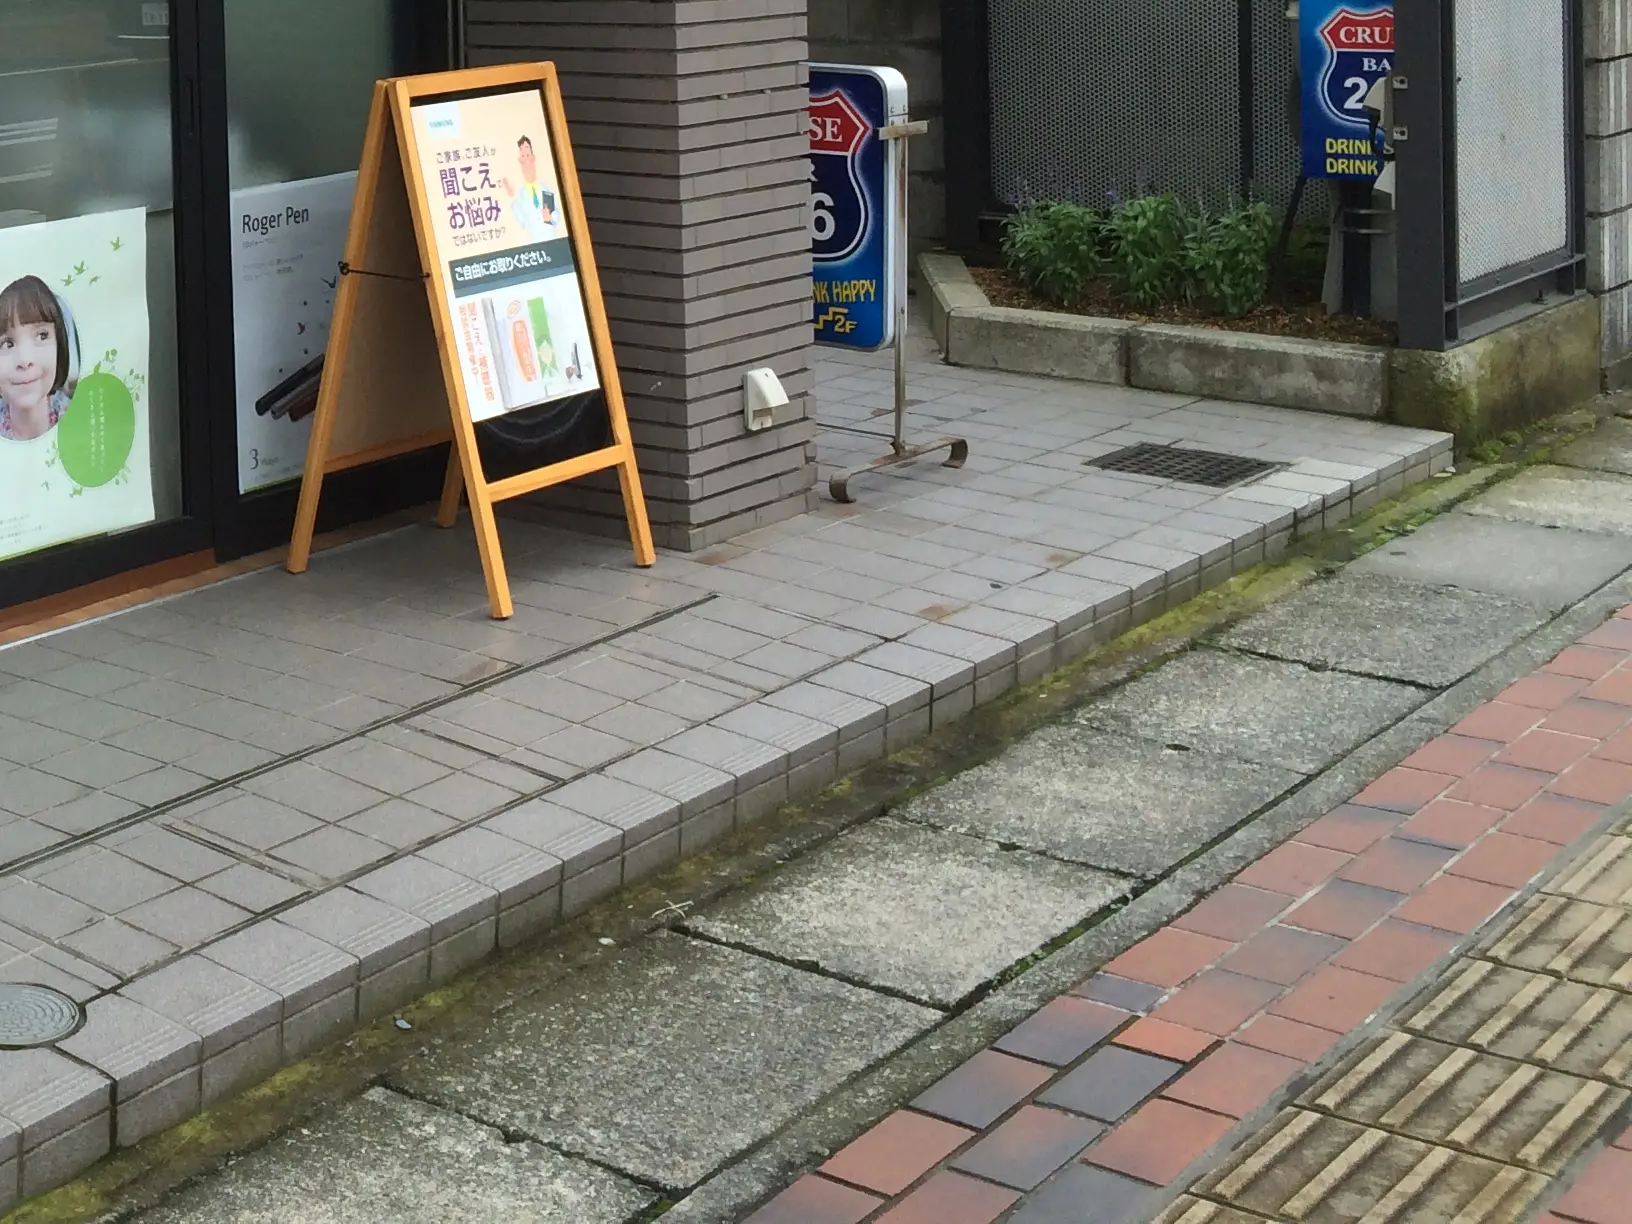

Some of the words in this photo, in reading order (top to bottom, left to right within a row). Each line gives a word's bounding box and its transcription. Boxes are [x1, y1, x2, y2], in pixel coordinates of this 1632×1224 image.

[1325, 158, 1378, 176] DRINK
[242, 212, 282, 235] Roger
[286, 206, 309, 226] Pen
[447, 196, 502, 230] お悩み
[455, 250, 552, 281] ご自由にお取りください。
[832, 278, 876, 303] HAPPY
